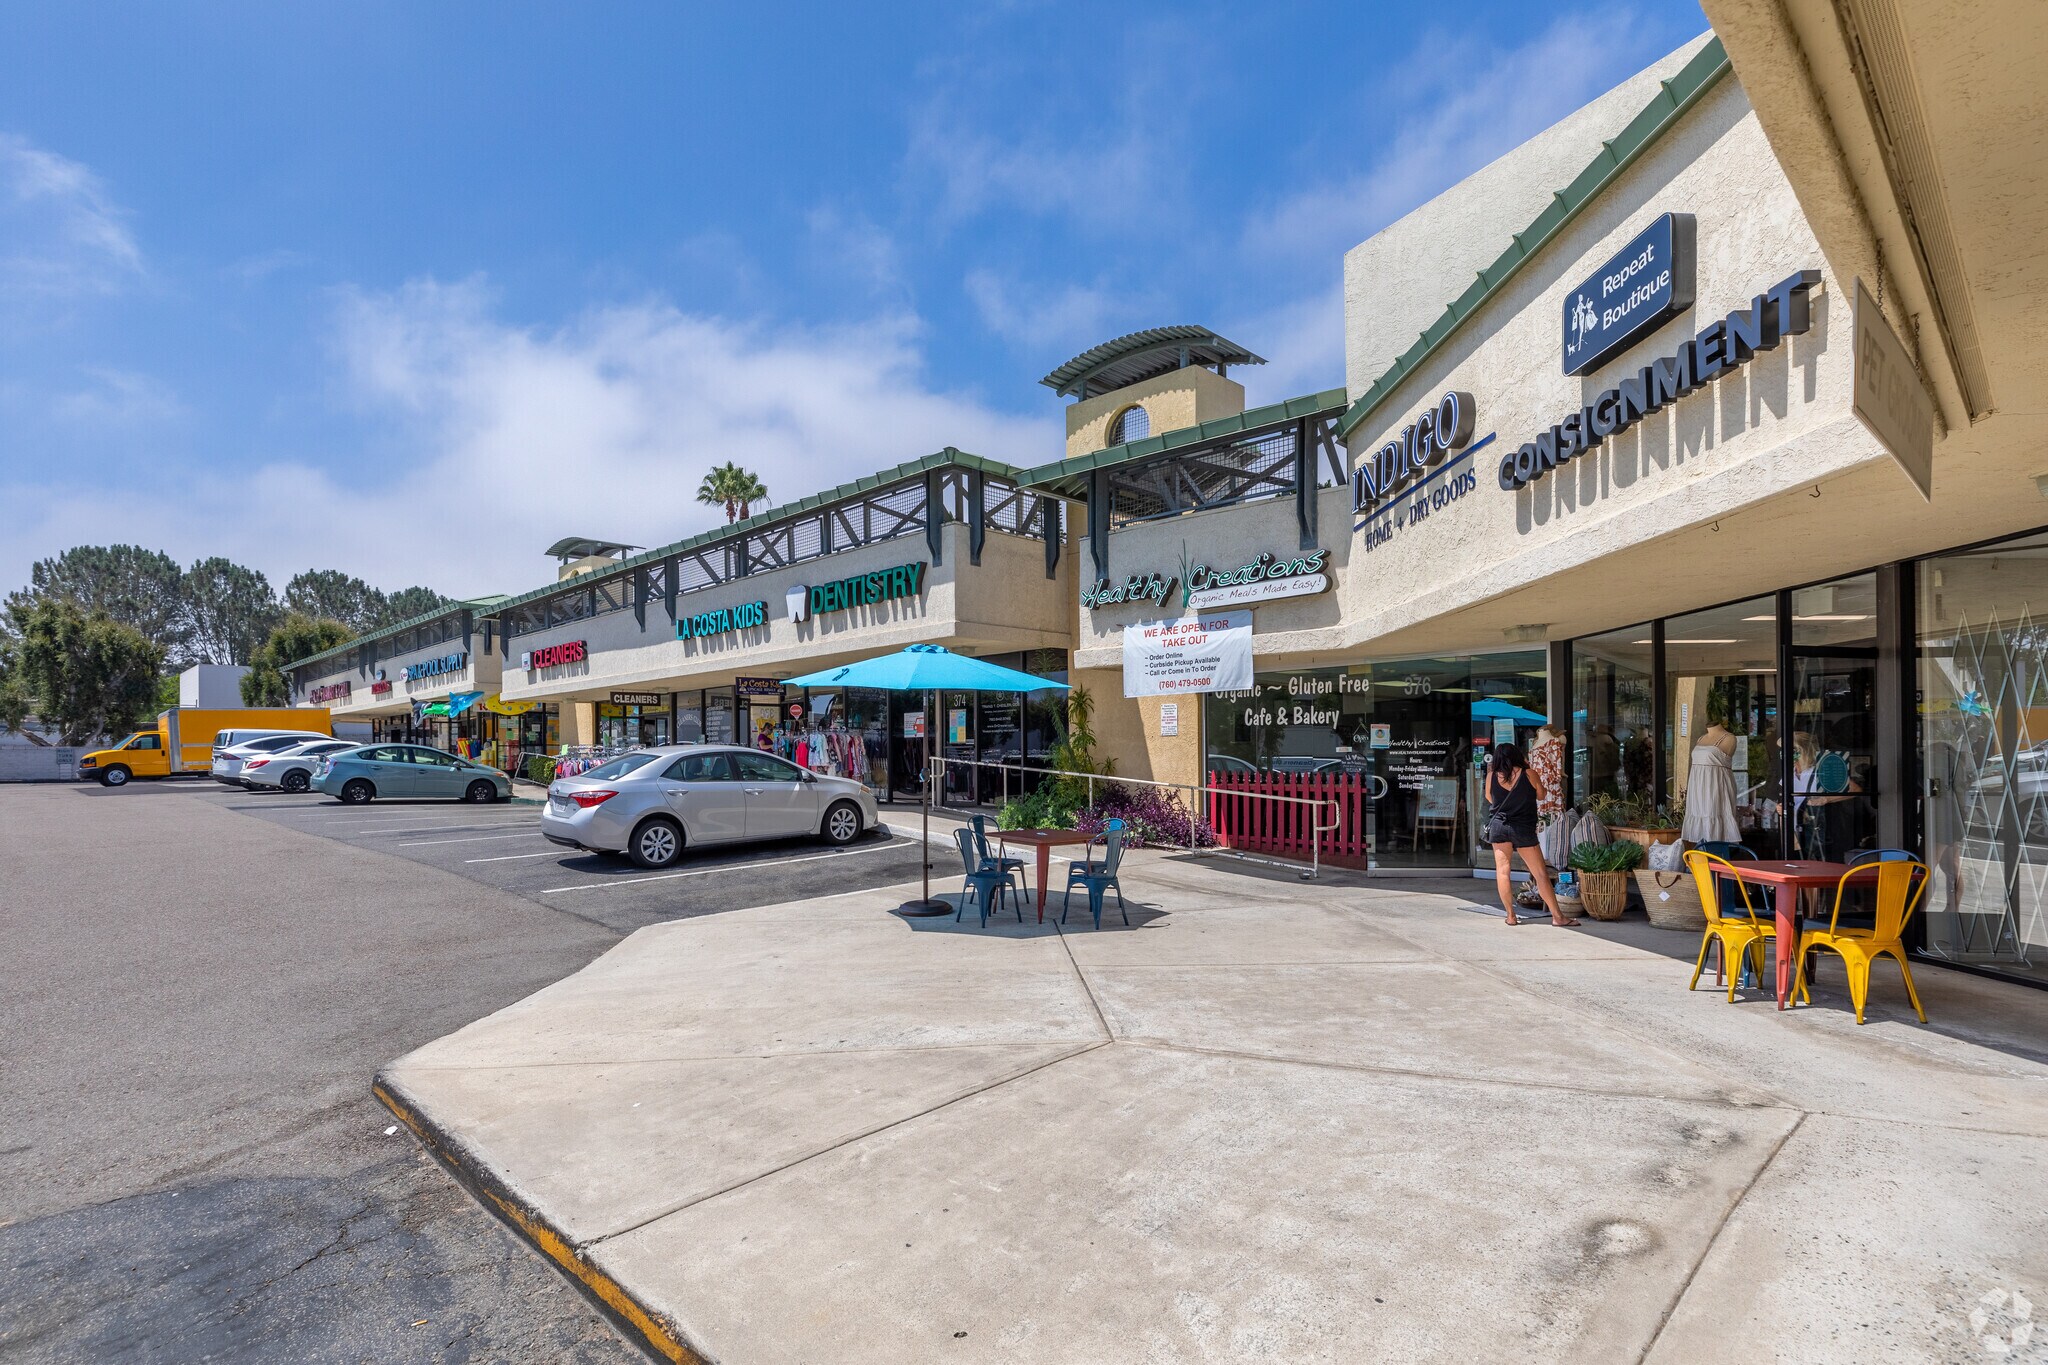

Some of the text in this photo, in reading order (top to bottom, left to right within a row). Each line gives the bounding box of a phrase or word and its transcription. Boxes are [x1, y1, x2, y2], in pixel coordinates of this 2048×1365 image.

[1602, 243, 1655, 298] Repeat
[1603, 269, 1670, 331] Boutique
[1498, 270, 1806, 491] CONSIGNMENT
[1861, 326, 1931, 468] PET GROOM
[1352, 391, 1460, 515] INDIGO
[1366, 520, 1393, 551] HOME
[1410, 495, 1431, 525] DRY
[1433, 467, 1477, 510] GOODS
[811, 562, 923, 614] DENTISTRY
[1081, 549, 1326, 609] Healthy Creations
[1190, 576, 1323, 608] Organic Meals Made Easy!
[676, 600, 764, 640] LA COSTA KIDS
[1144, 620, 1229, 638] WE ARE OPEN FOR
[534, 639, 585, 668] CLEANERS
[1162, 635, 1208, 648] TAKE OUT
[422, 659, 440, 677] POOL
[441, 653, 464, 673] SUPPLY
[1149, 656, 1220, 669] Curbside Pickup Available
[1159, 677, 1211, 690] (760) 479-0500
[1288, 676, 1333, 695] Gluten
[1339, 674, 1370, 693] Free
[1404, 676, 1431, 696] 376
[614, 694, 658, 704] CLEANERS
[953, 694, 966, 707] 374
[1244, 705, 1340, 729] Cafe & Bakery
[1399, 782, 1413, 790] Sunday
